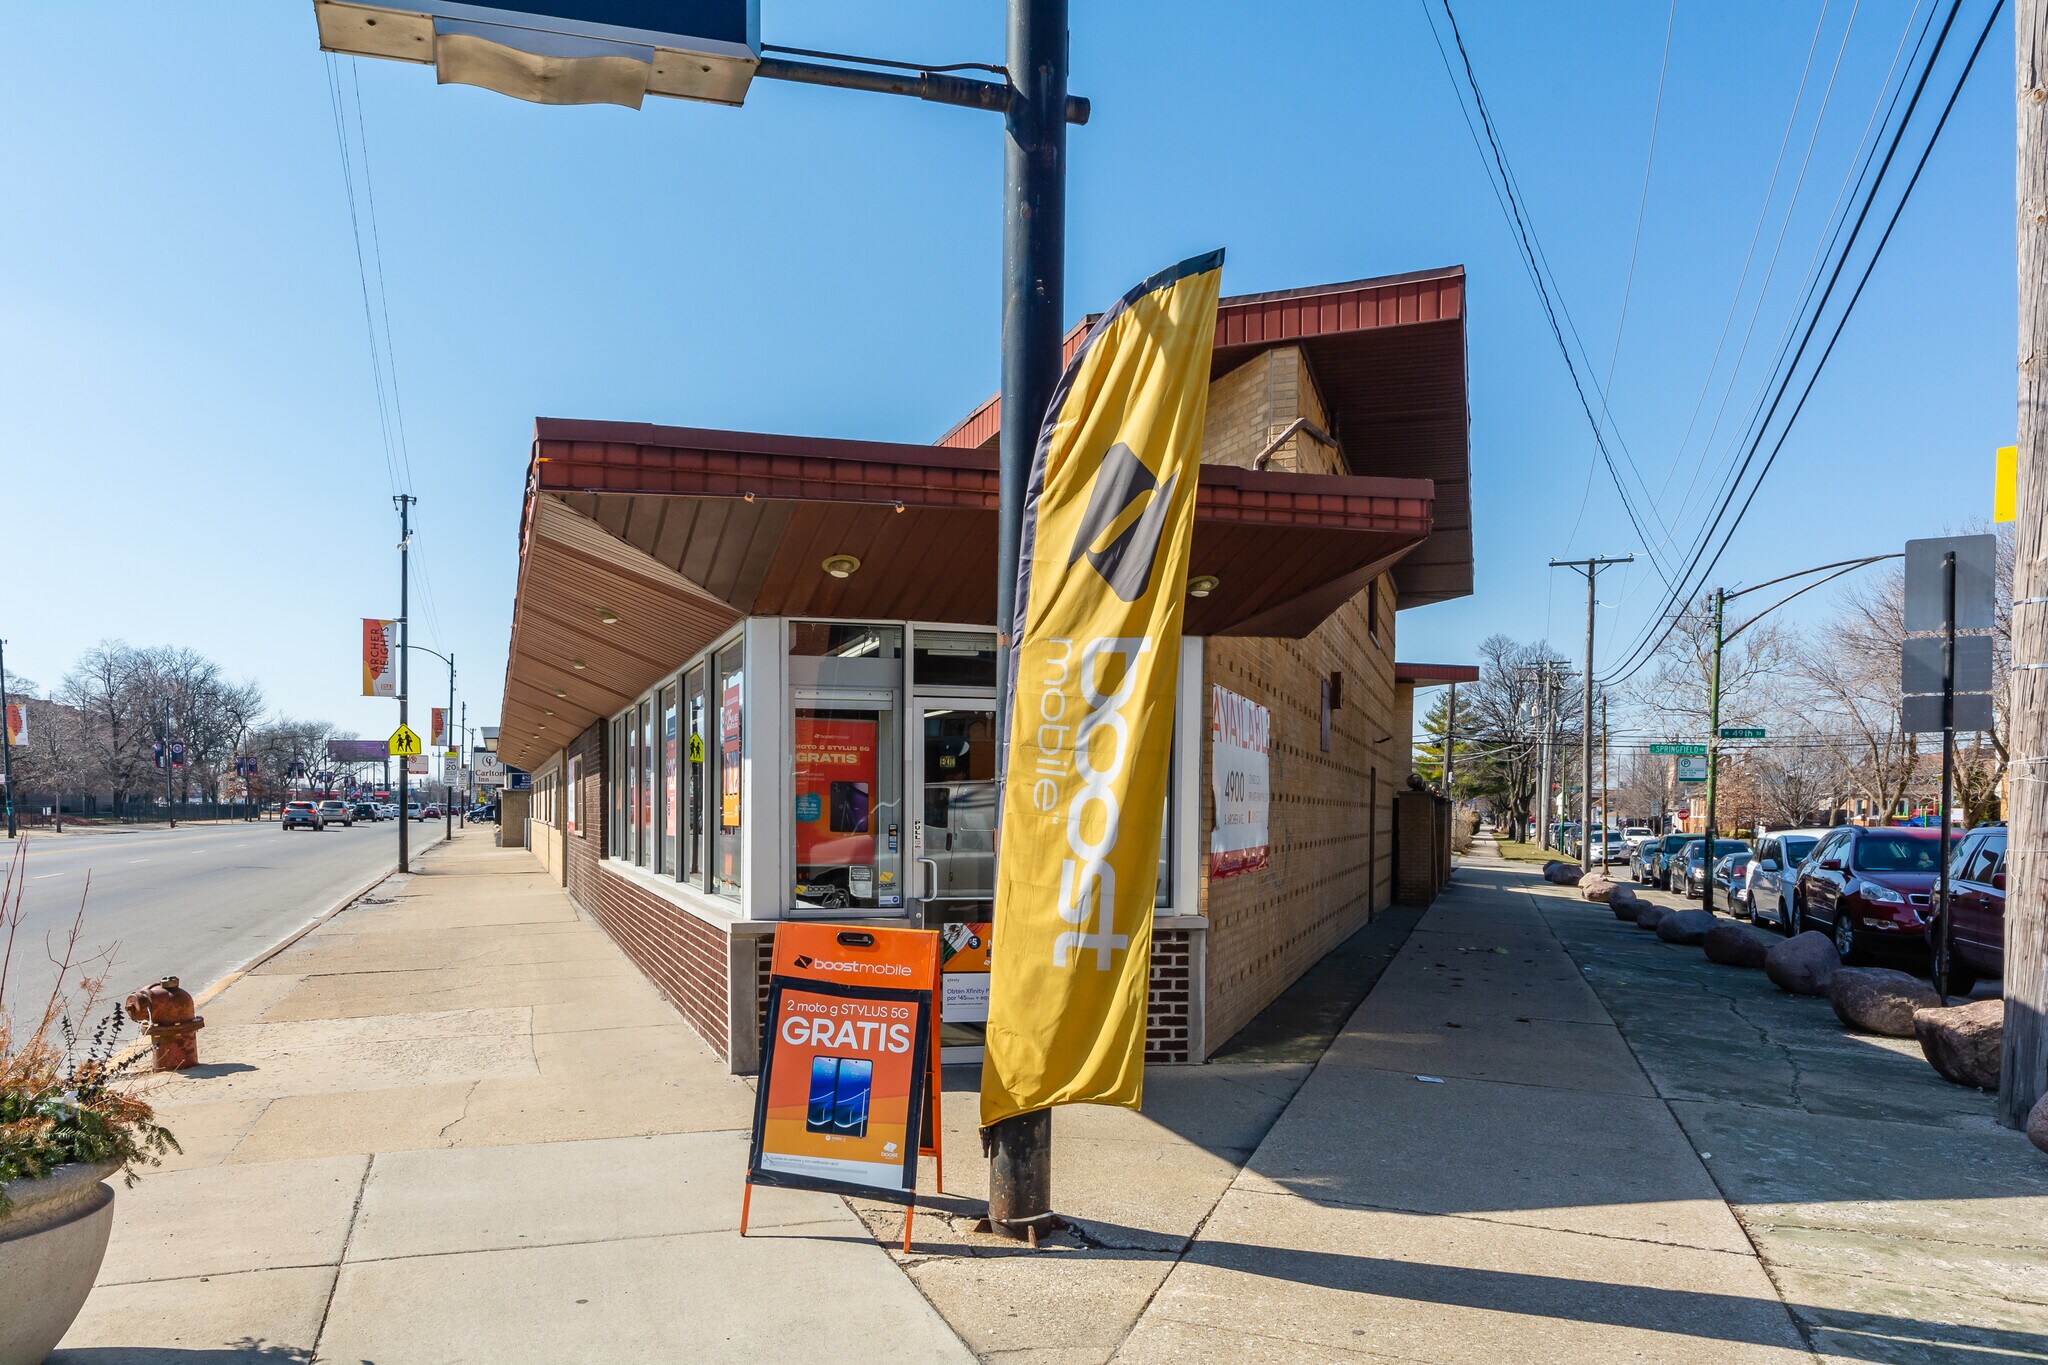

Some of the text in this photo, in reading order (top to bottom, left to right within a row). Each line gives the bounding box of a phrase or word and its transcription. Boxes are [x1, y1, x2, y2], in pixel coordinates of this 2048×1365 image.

[370, 628, 380, 673] ARCHER
[379, 626, 390, 674] HEIGHTS
[1033, 637, 1073, 811] mobile
[1732, 729, 1753, 737] 49th
[796, 752, 858, 764] GRATIS
[1656, 745, 1698, 753] SPRINGFIELD
[475, 769, 505, 777] Carlton
[1224, 770, 1244, 803] 4900
[1053, 636, 1153, 970] boost
[807, 884, 834, 893] boost
[965, 987, 985, 996] Xfinity
[787, 999, 910, 1020] 2 moto g STYLUS 5G
[781, 1015, 911, 1054] GRATIS
